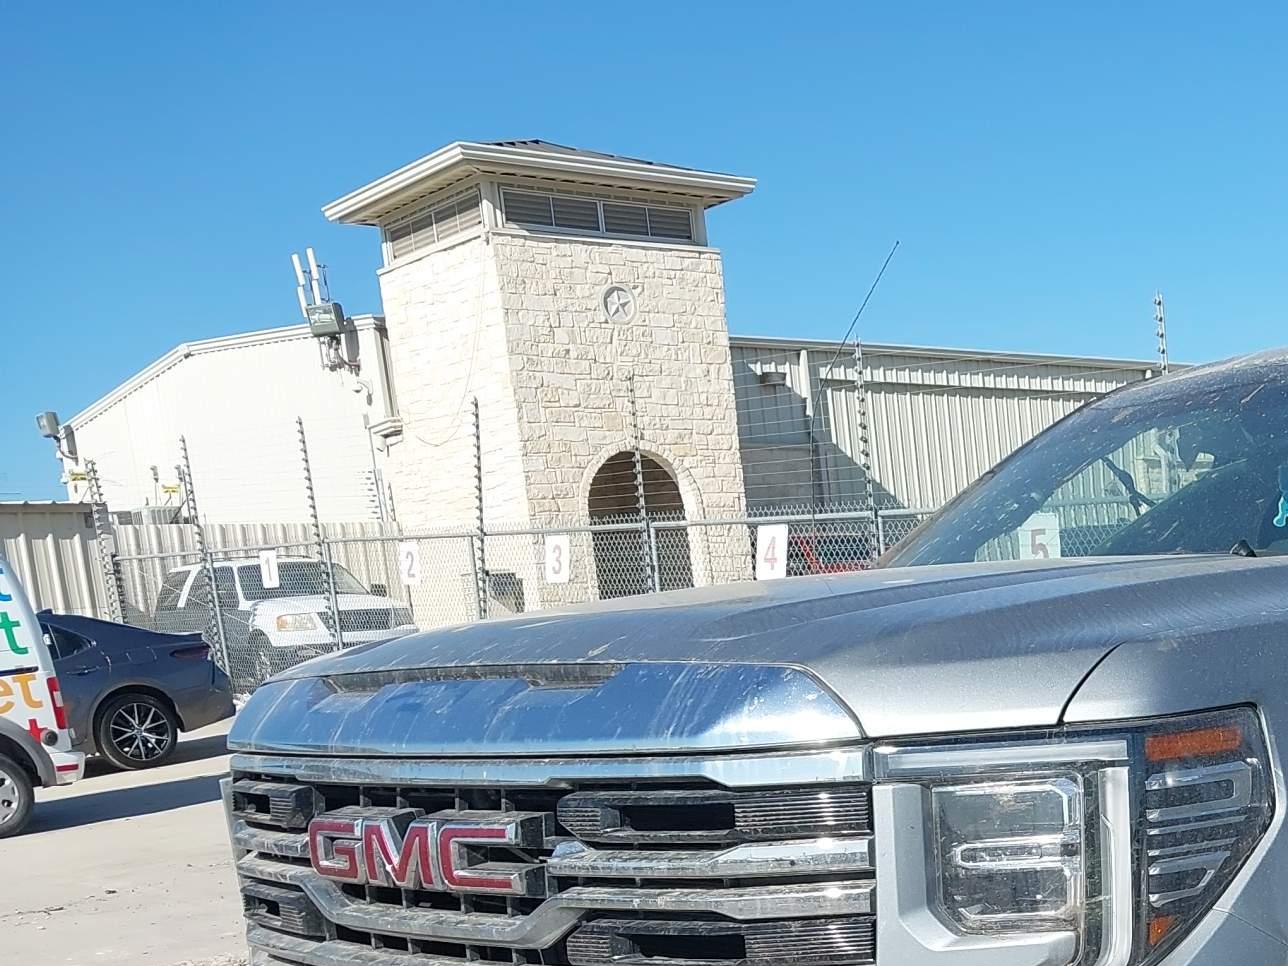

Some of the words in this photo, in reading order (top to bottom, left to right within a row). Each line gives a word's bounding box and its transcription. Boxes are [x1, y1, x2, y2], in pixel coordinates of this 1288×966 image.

[763, 536, 778, 571] 4
[1030, 528, 1050, 559] 5
[265, 556, 273, 582] 1
[405, 551, 417, 578] 2
[551, 544, 563, 575] 3
[308, 815, 530, 896] GMC
